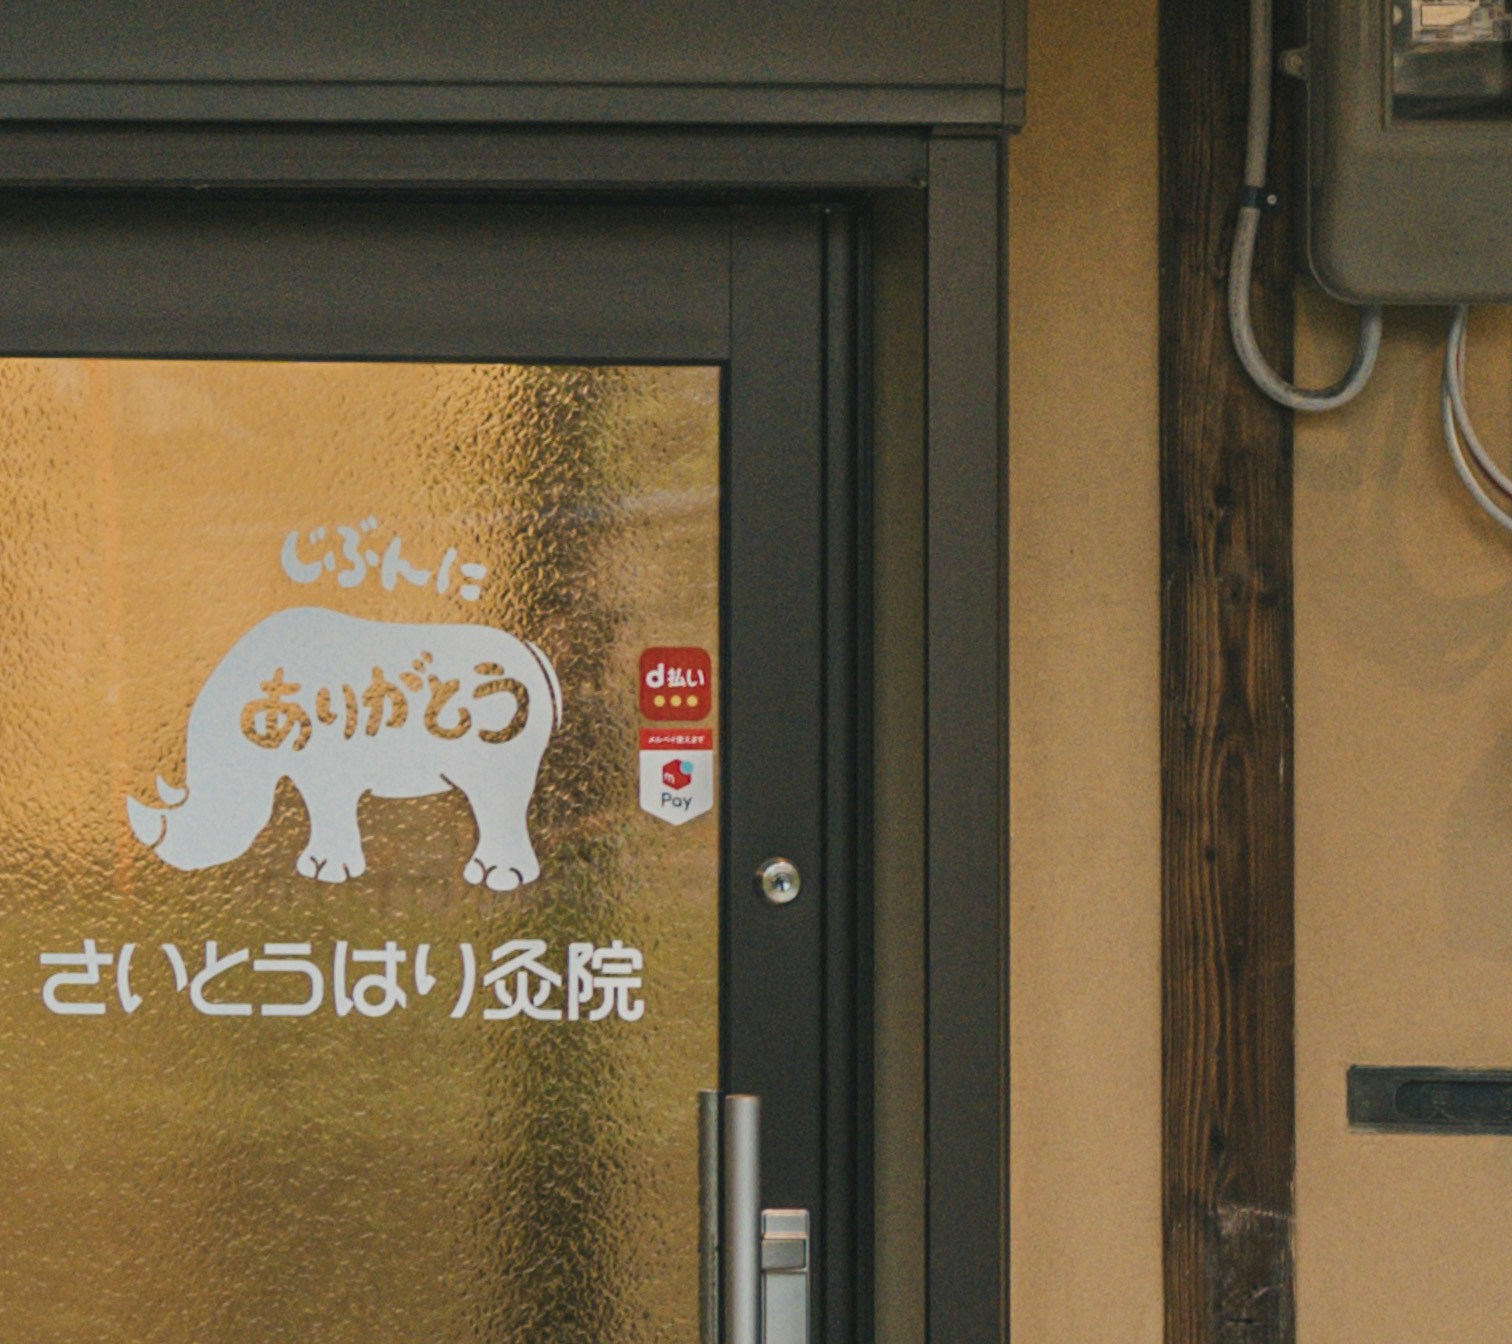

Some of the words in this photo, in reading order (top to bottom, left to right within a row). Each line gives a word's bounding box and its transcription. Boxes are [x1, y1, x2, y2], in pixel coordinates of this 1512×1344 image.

[281, 516, 488, 601] じぶんに
[240, 651, 530, 751] ありがとう
[645, 662, 705, 689] d払い
[661, 791, 693, 811] Pay
[39, 938, 646, 1024] さいとうはり灸院
